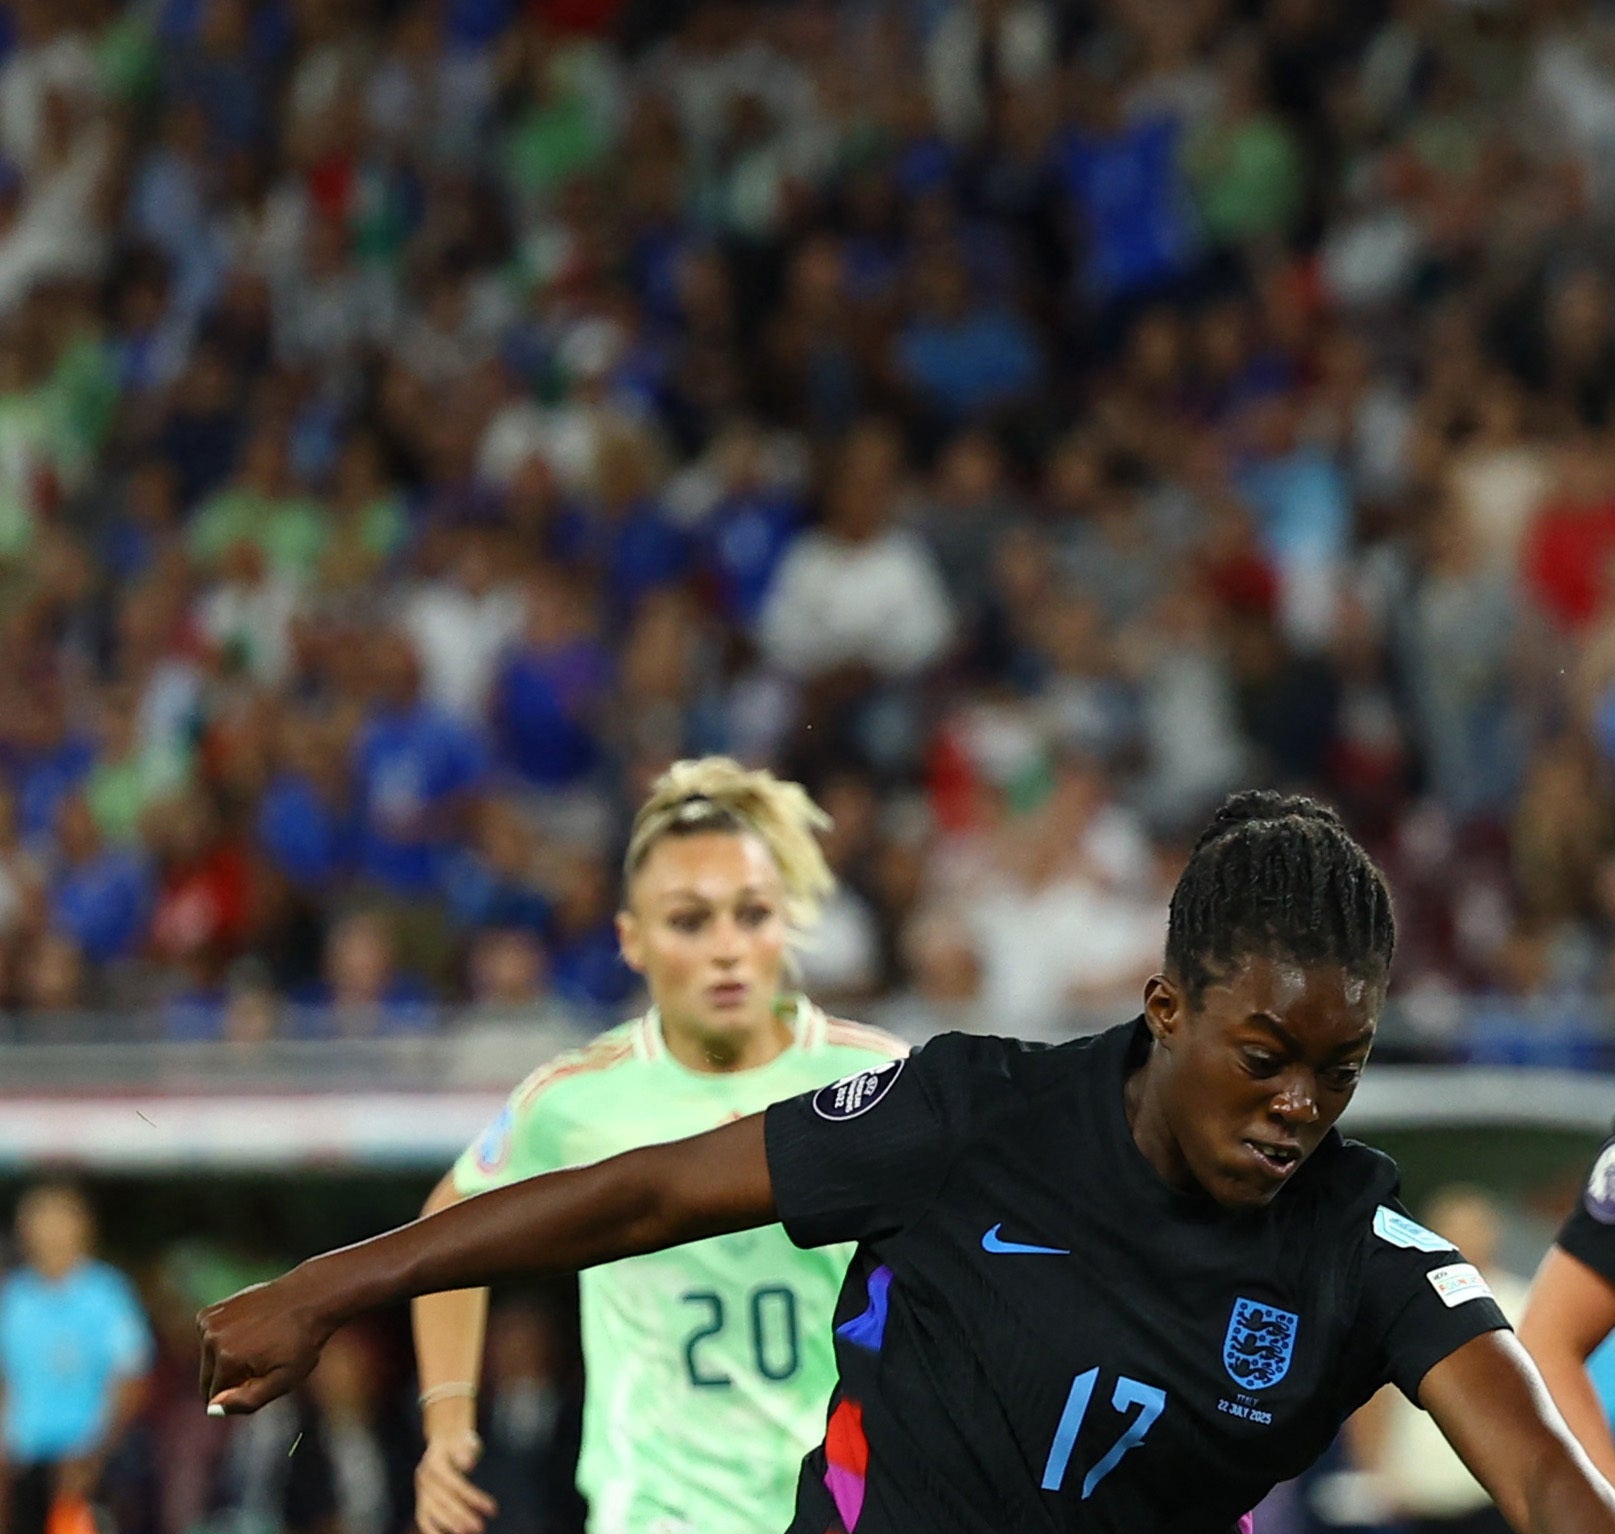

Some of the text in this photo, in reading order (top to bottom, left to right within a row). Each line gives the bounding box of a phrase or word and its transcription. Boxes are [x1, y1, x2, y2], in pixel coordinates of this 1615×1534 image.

[682, 1283, 799, 1388] 20
[1041, 1366, 1166, 1500] 17
[1218, 1399, 1229, 1412] 22
[1229, 1402, 1249, 1418] JULY
